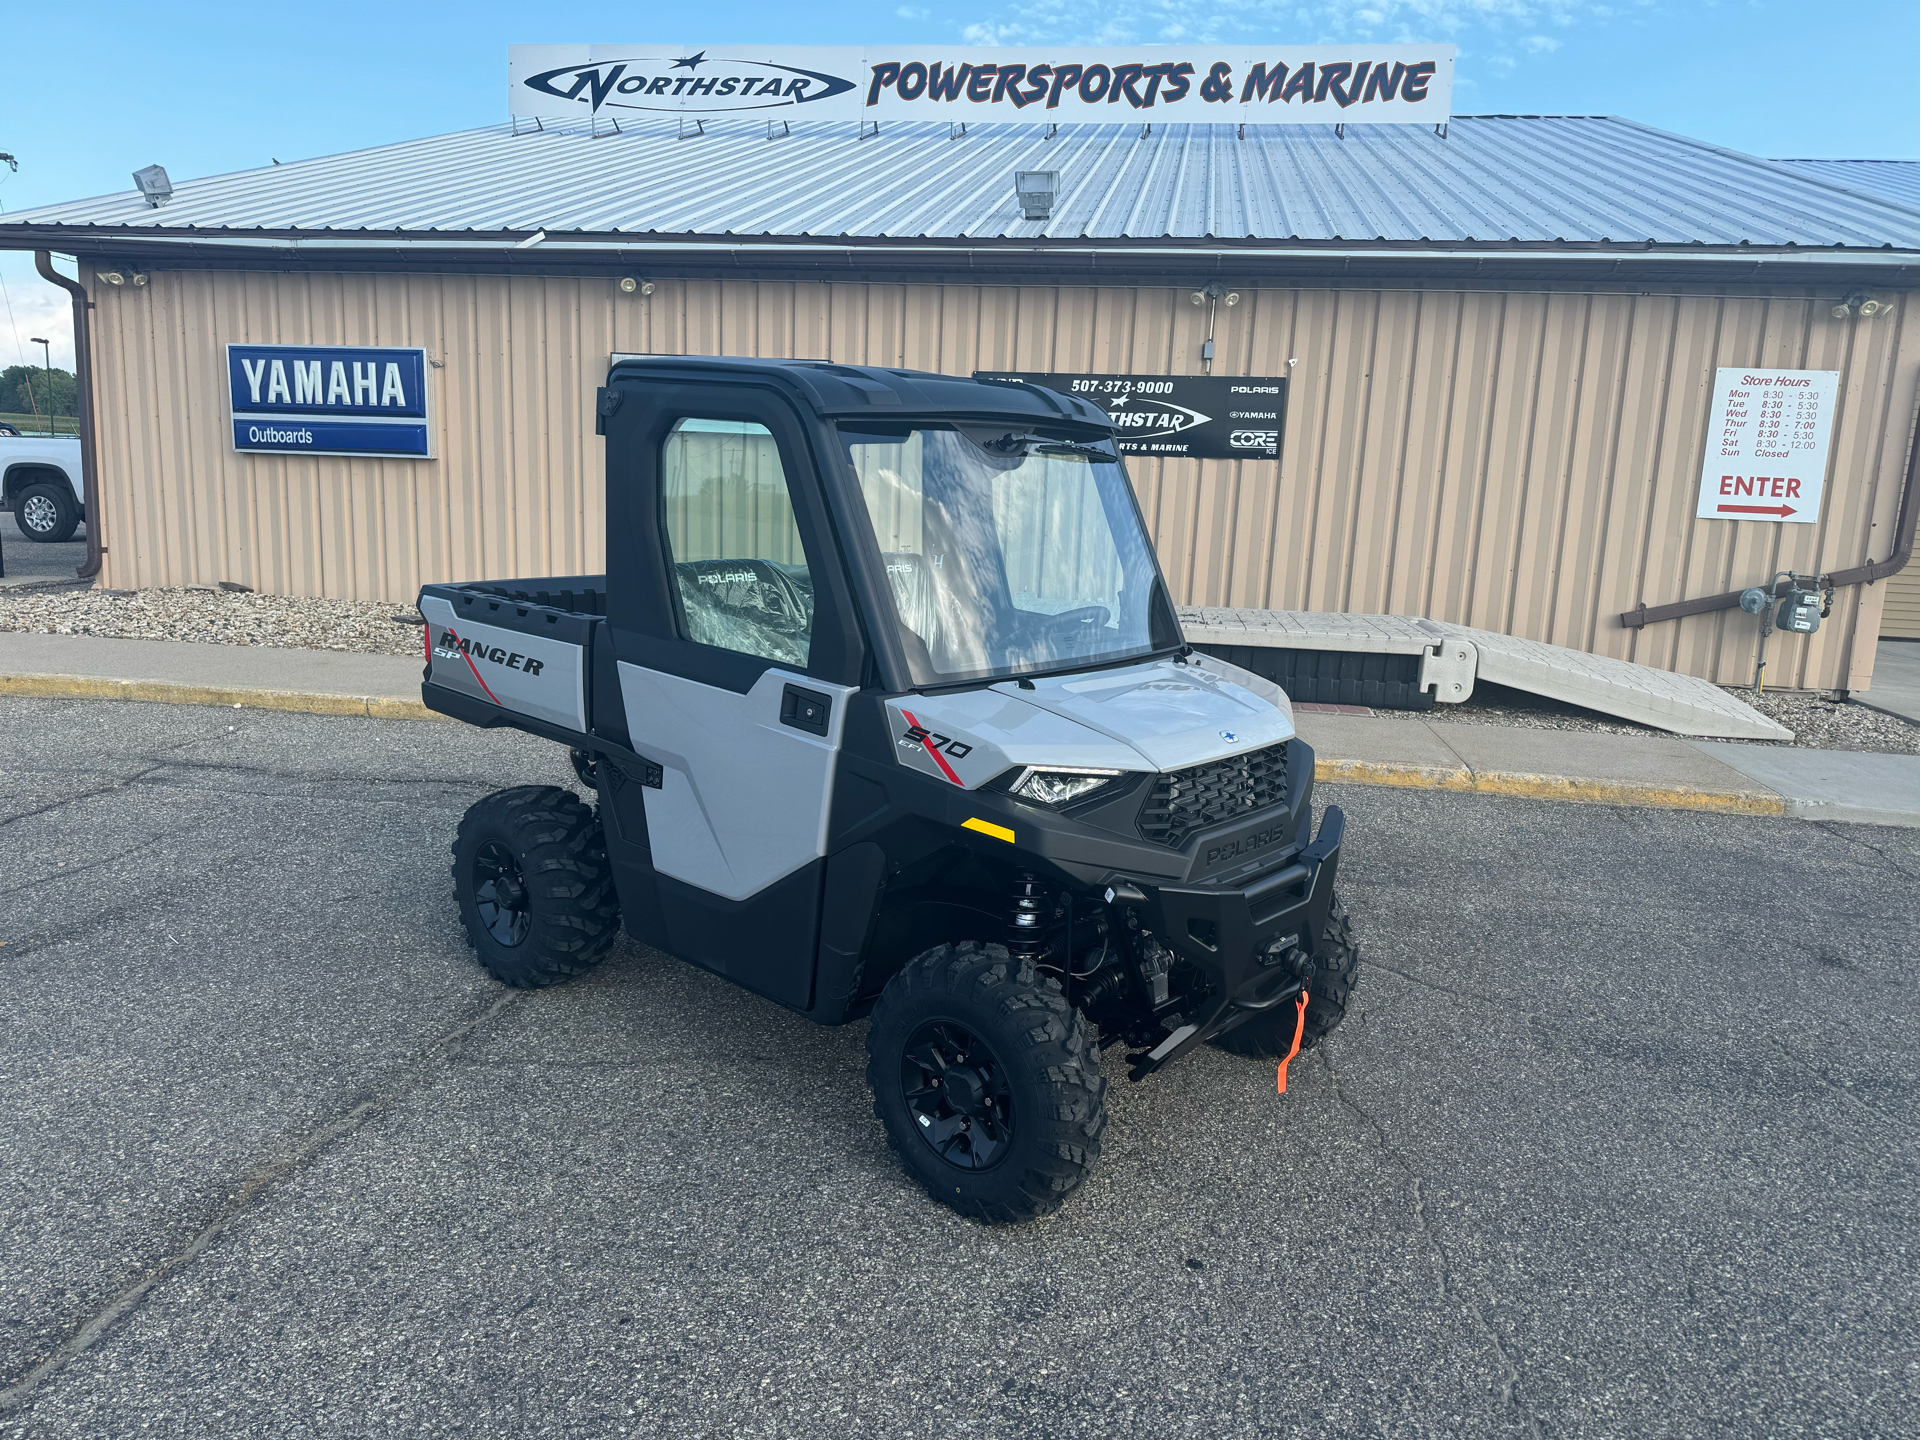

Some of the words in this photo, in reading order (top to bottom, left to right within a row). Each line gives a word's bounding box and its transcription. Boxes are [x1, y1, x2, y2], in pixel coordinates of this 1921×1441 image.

[567, 64, 811, 114] NORTHSTAR
[867, 61, 1195, 109] POWERSPORTS
[1200, 62, 1234, 104] &
[1240, 61, 1436, 108] MARINE
[241, 359, 406, 406] YAMAHA
[1071, 380, 1174, 393] 507-373-9000
[1741, 374, 1772, 386] Store
[1774, 376, 1811, 387] Hours
[1230, 386, 1279, 394] POLARIS
[1729, 390, 1750, 398] Mon
[1763, 391, 1784, 399] 8:30
[1798, 392, 1819, 400] 5:30
[1728, 400, 1745, 408] Tue
[1762, 401, 1783, 409] 8:30
[1797, 402, 1818, 410] 5:30
[1726, 409, 1748, 417] Wed
[1760, 411, 1782, 419] 8:30
[1796, 412, 1817, 420] 5:30
[1108, 412, 1184, 432] THSTAR
[1725, 419, 1747, 427] Thur
[1759, 420, 1780, 428] 8:30
[1795, 421, 1816, 429] 7:00
[249, 426, 313, 444] Outboards
[1230, 432, 1278, 447] CORE
[1723, 429, 1737, 437] Fri
[1757, 430, 1779, 438] 8:30
[1793, 431, 1814, 440] 5:30
[1151, 444, 1189, 452] MARINE
[1722, 438, 1738, 446] Sat
[1756, 440, 1777, 448] 8:30
[1791, 441, 1816, 449] 12:00
[1720, 448, 1740, 456] Sun
[1754, 449, 1789, 458] Closed
[1719, 475, 1801, 498] ENTER
[886, 564, 912, 573] ARIS
[698, 572, 757, 584] POLARIS
[433, 647, 461, 659] SP
[439, 632, 544, 676] RANGER
[898, 739, 923, 752] EFI
[903, 725, 973, 759] 570
[1206, 824, 1284, 867] POLARIS
